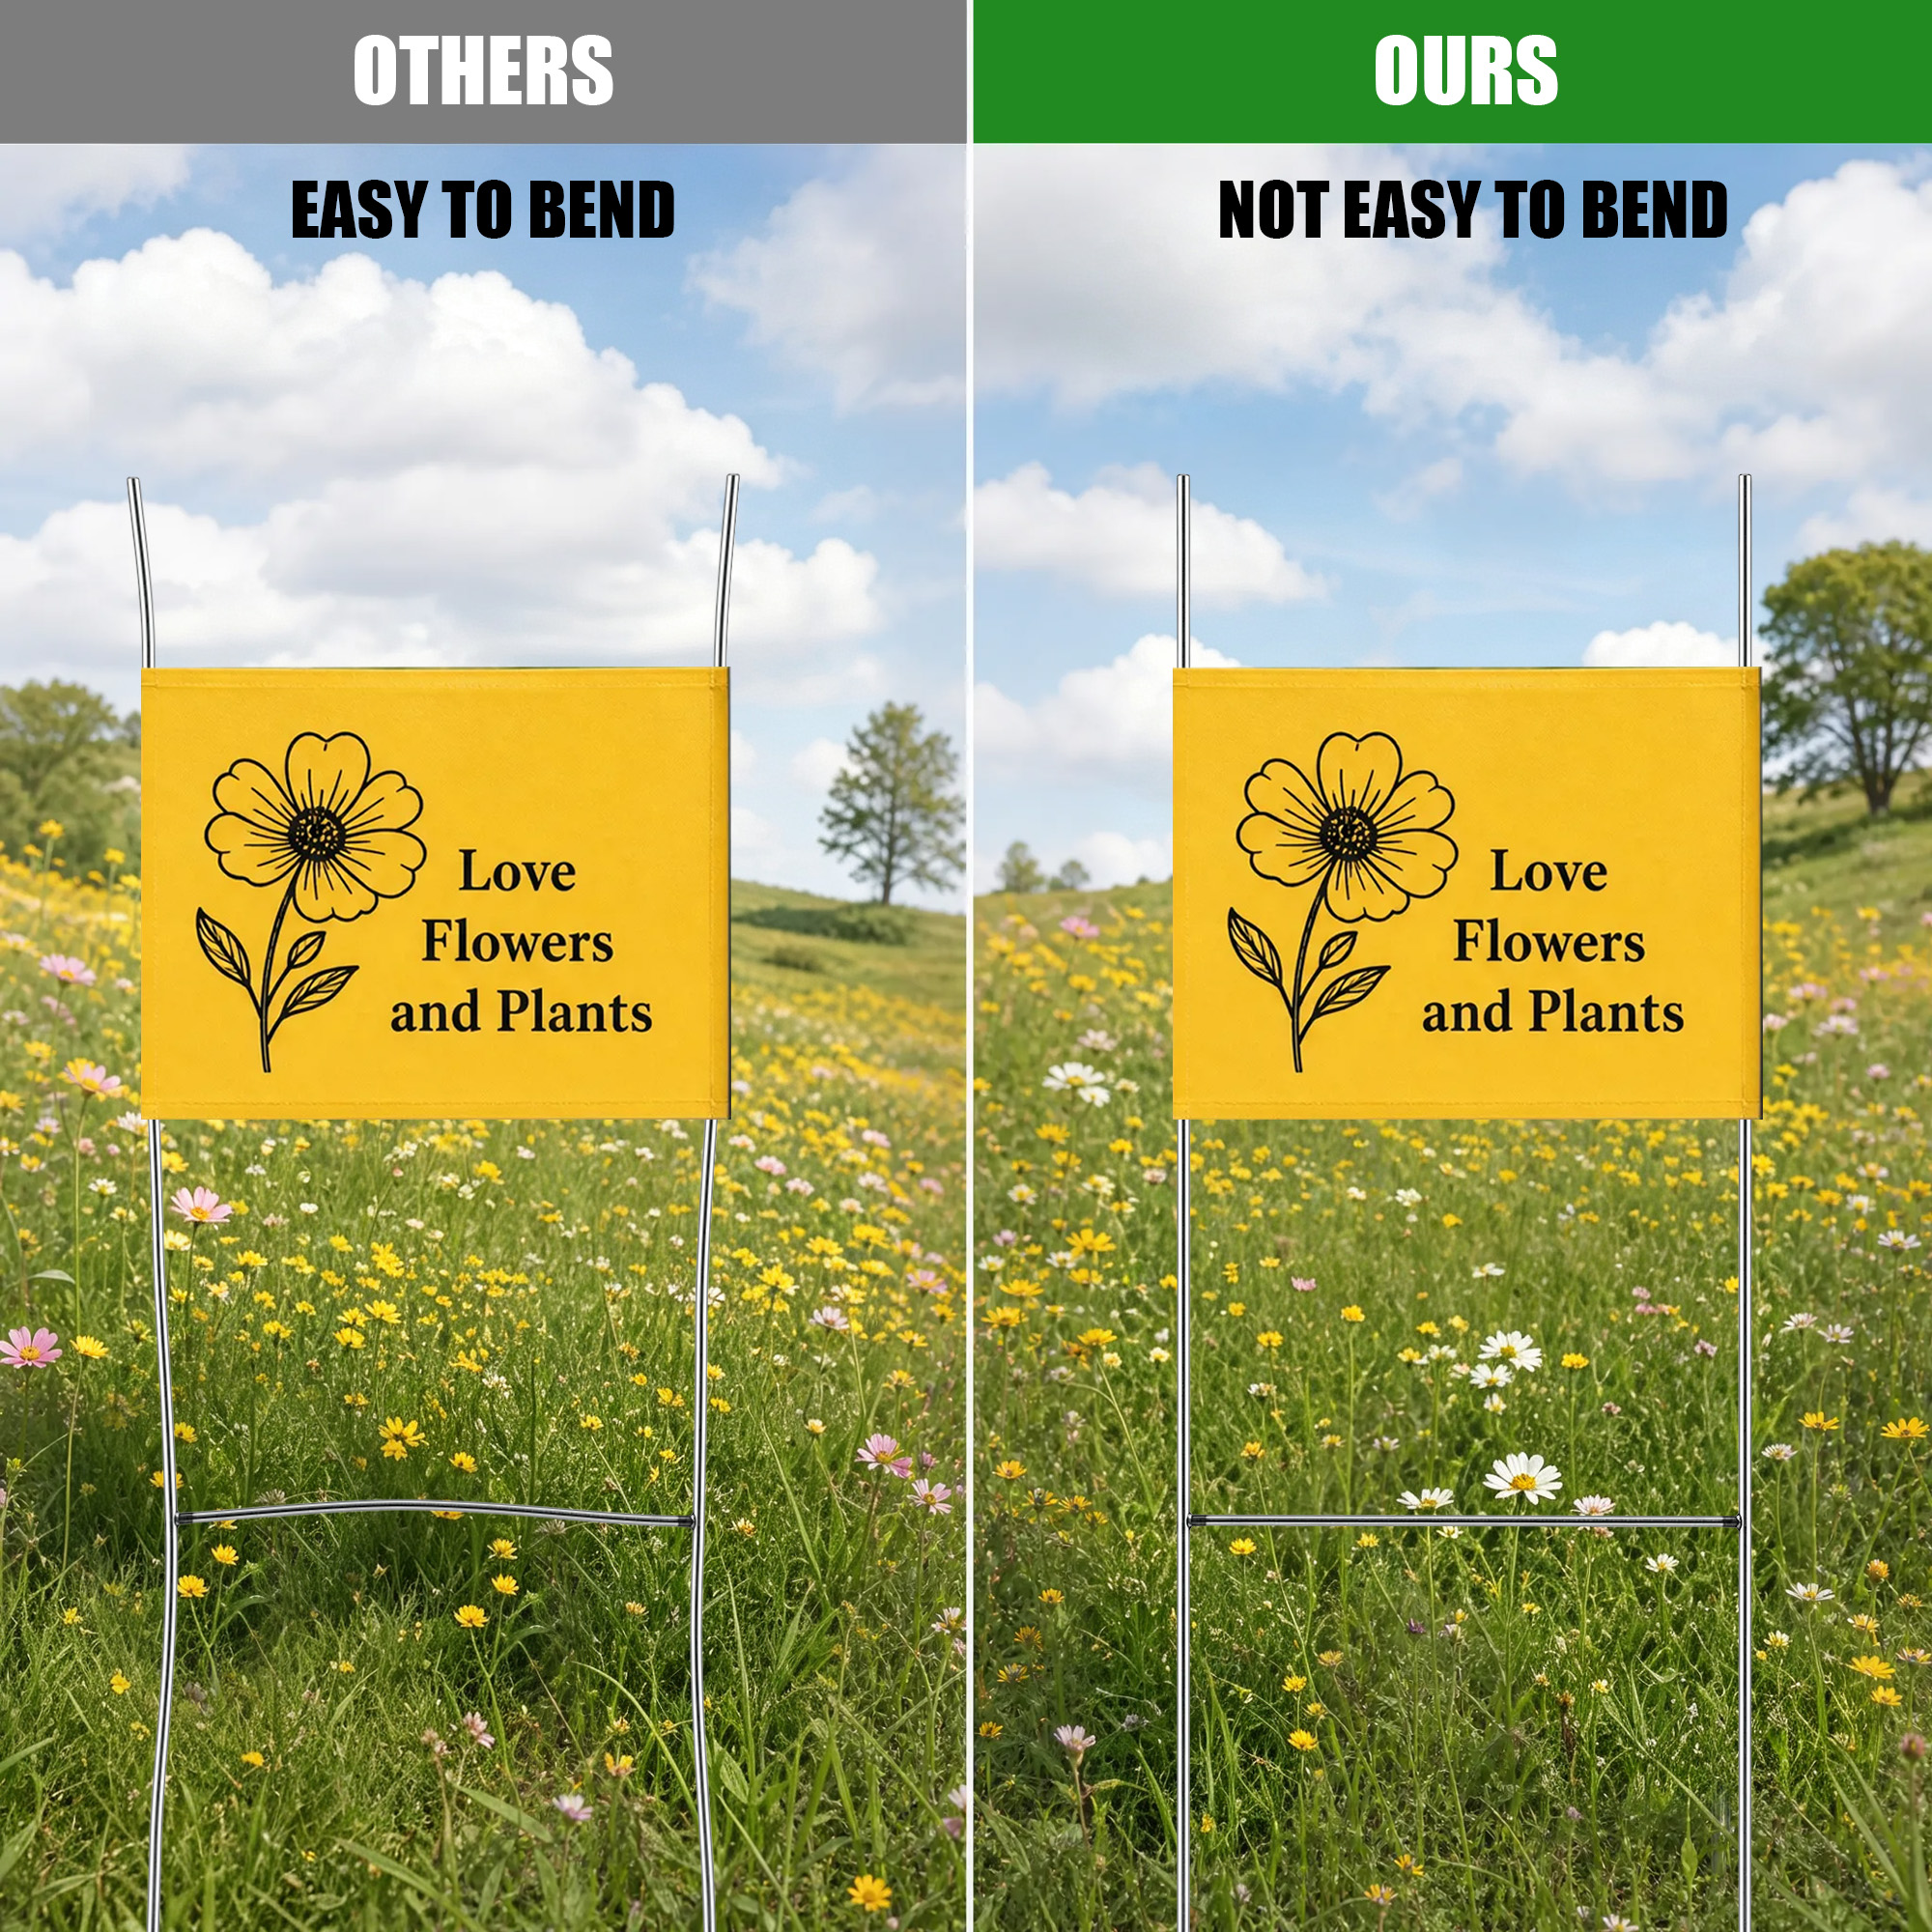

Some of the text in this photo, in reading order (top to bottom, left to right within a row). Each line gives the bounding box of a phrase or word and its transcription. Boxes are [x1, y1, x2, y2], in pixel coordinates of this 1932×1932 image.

[459, 848, 576, 892] Love
[1491, 848, 1607, 892] Love
[422, 919, 613, 963] Flowers
[1454, 919, 1645, 963] Flowers
[390, 988, 652, 1033] and Plants
[1422, 988, 1684, 1033] and Plants
